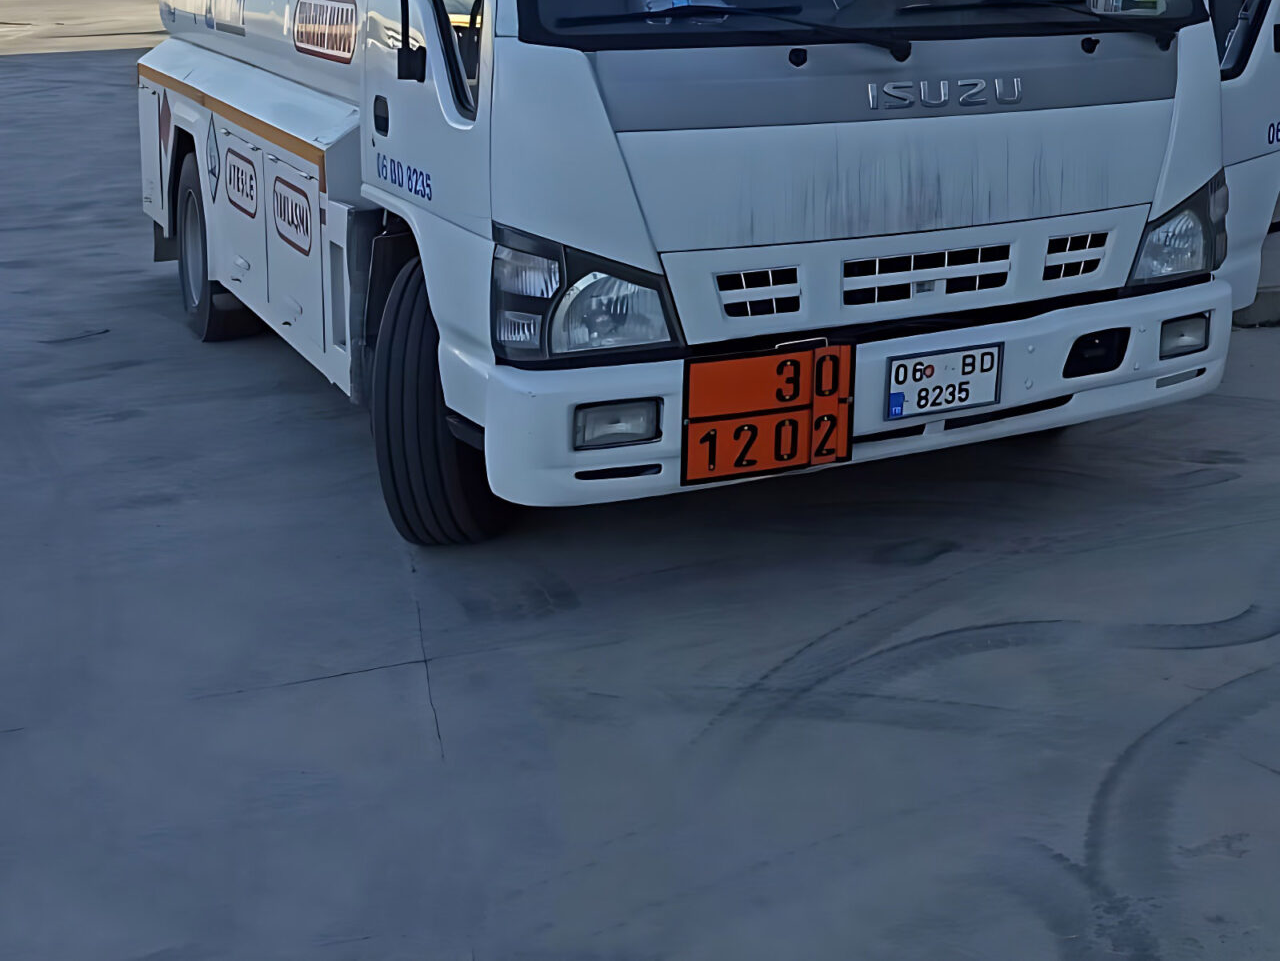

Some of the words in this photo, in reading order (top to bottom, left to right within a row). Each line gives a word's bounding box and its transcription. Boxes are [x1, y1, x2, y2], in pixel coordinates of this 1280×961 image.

[867, 77, 1022, 110] ISUZU
[406, 165, 433, 201] 8235
[775, 354, 840, 403] 30
[894, 361, 925, 385] 06
[961, 351, 995, 376] BD
[916, 380, 971, 409] 8235
[698, 413, 838, 471] 1202
